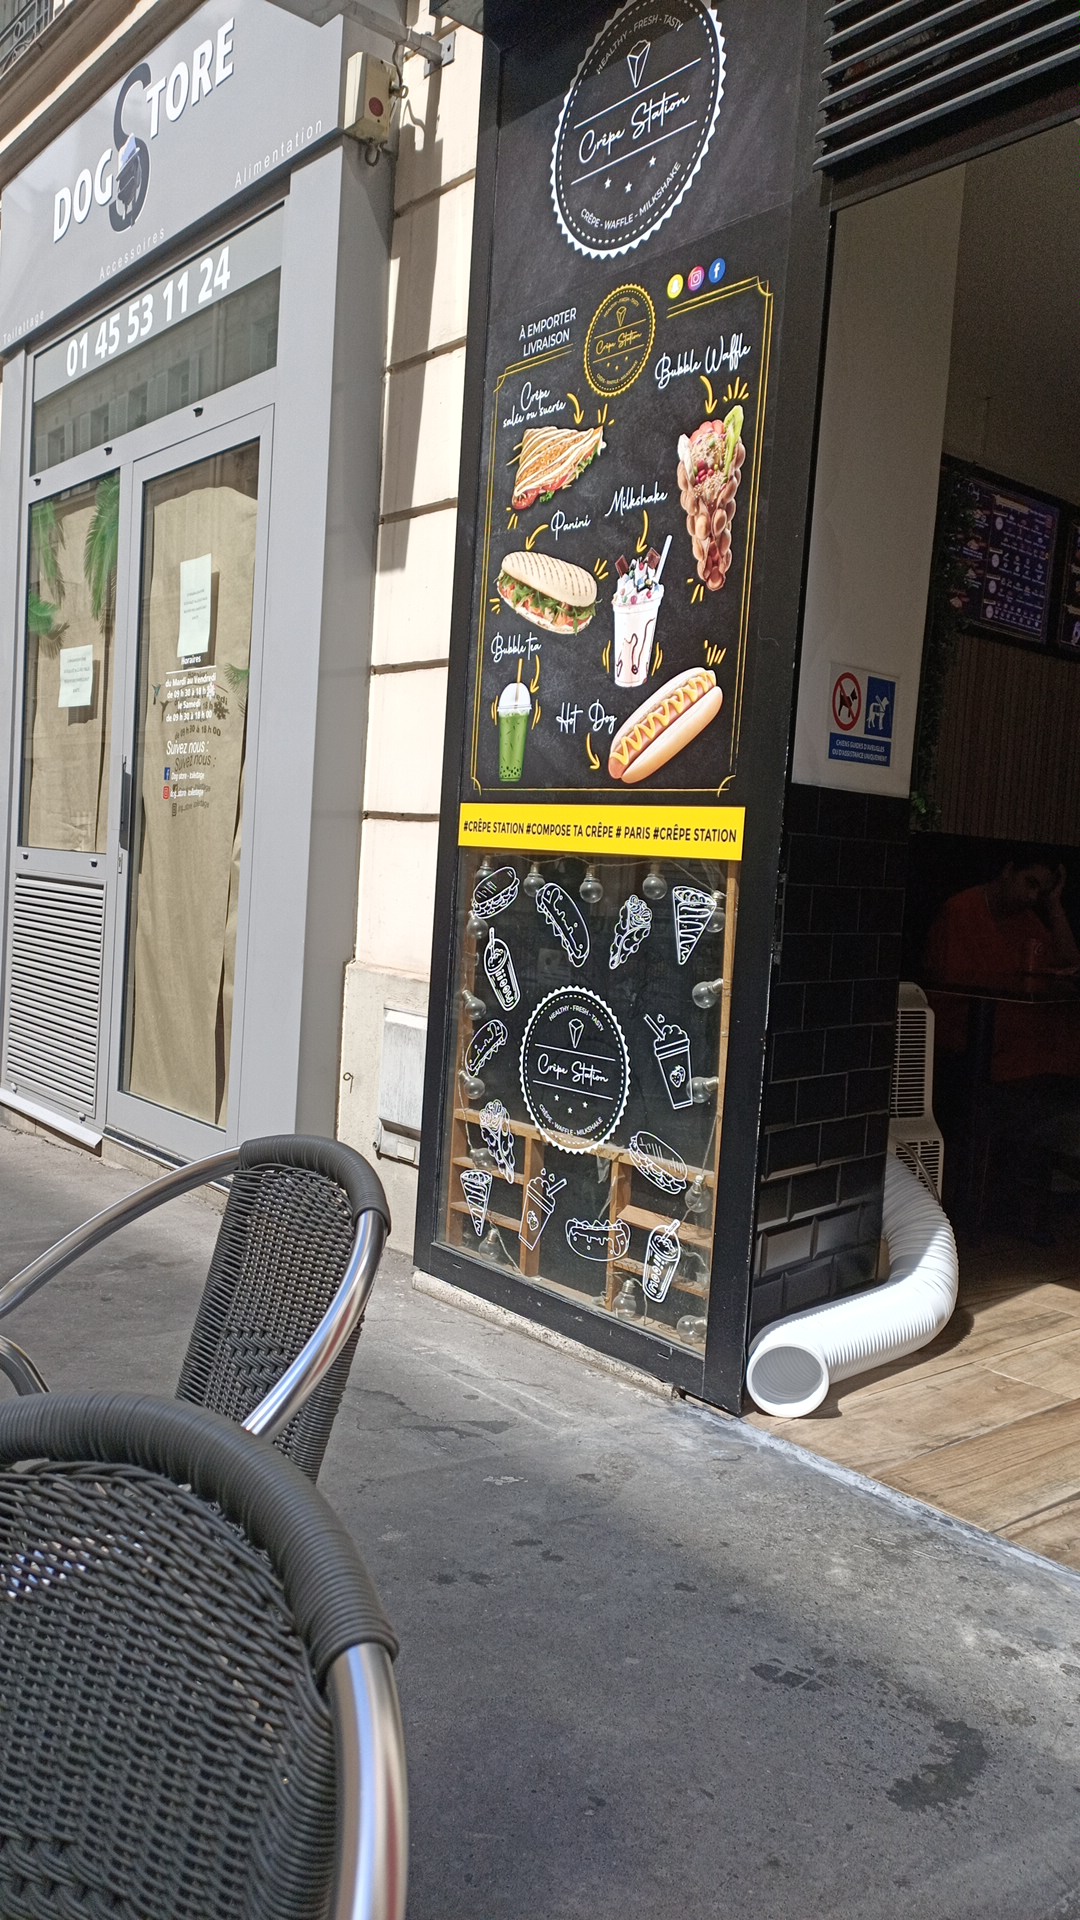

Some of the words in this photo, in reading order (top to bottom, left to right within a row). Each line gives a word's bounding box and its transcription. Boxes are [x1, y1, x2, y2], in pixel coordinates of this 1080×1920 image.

[596, 33, 628, 75] HEALTHY
[634, 14, 659, 31] FRESH
[663, 14, 684, 32] TASTY
[630, 91, 691, 140] Station
[234, 119, 323, 189] Alimentation
[53, 148, 114, 243] DOG
[603, 214, 634, 230] WAFFLE
[639, 161, 682, 215] MILKSHAKE
[99, 227, 166, 281] Accessoires
[66, 331, 88, 377] 01
[94, 312, 121, 359] 45
[127, 293, 154, 344] 53
[162, 270, 190, 323] 11
[197, 246, 231, 305] 24
[527, 307, 577, 336] EMPORTER
[523, 328, 570, 357] LIVRAISON
[655, 352, 702, 390] Bubble
[704, 332, 751, 373] Waffle
[604, 481, 668, 517] Milkshake
[550, 509, 591, 541] Panini
[491, 632, 526, 663] Bubble
[556, 702, 583, 733] Hot
[588, 699, 617, 733] Dog
[166, 740, 188, 755] Suivez
[188, 740, 206, 753] nous
[463, 818, 492, 833] #CRÊPE
[493, 821, 524, 835] STATION
[526, 822, 571, 837] #COMPOSE
[573, 824, 584, 837] TA
[585, 821, 614, 838] CRÊPE
[624, 826, 651, 840] PARIS
[652, 823, 692, 842] #CRÊPE
[693, 827, 737, 843] STATION
[548, 1005, 570, 1022] HEALTHY
[572, 1005, 589, 1016] FRESH
[591, 1014, 604, 1032] TASTY
[571, 1060, 609, 1087] Station
[554, 1122, 574, 1136] WAFFLE
[576, 1116, 603, 1136] MILKSHAKE
